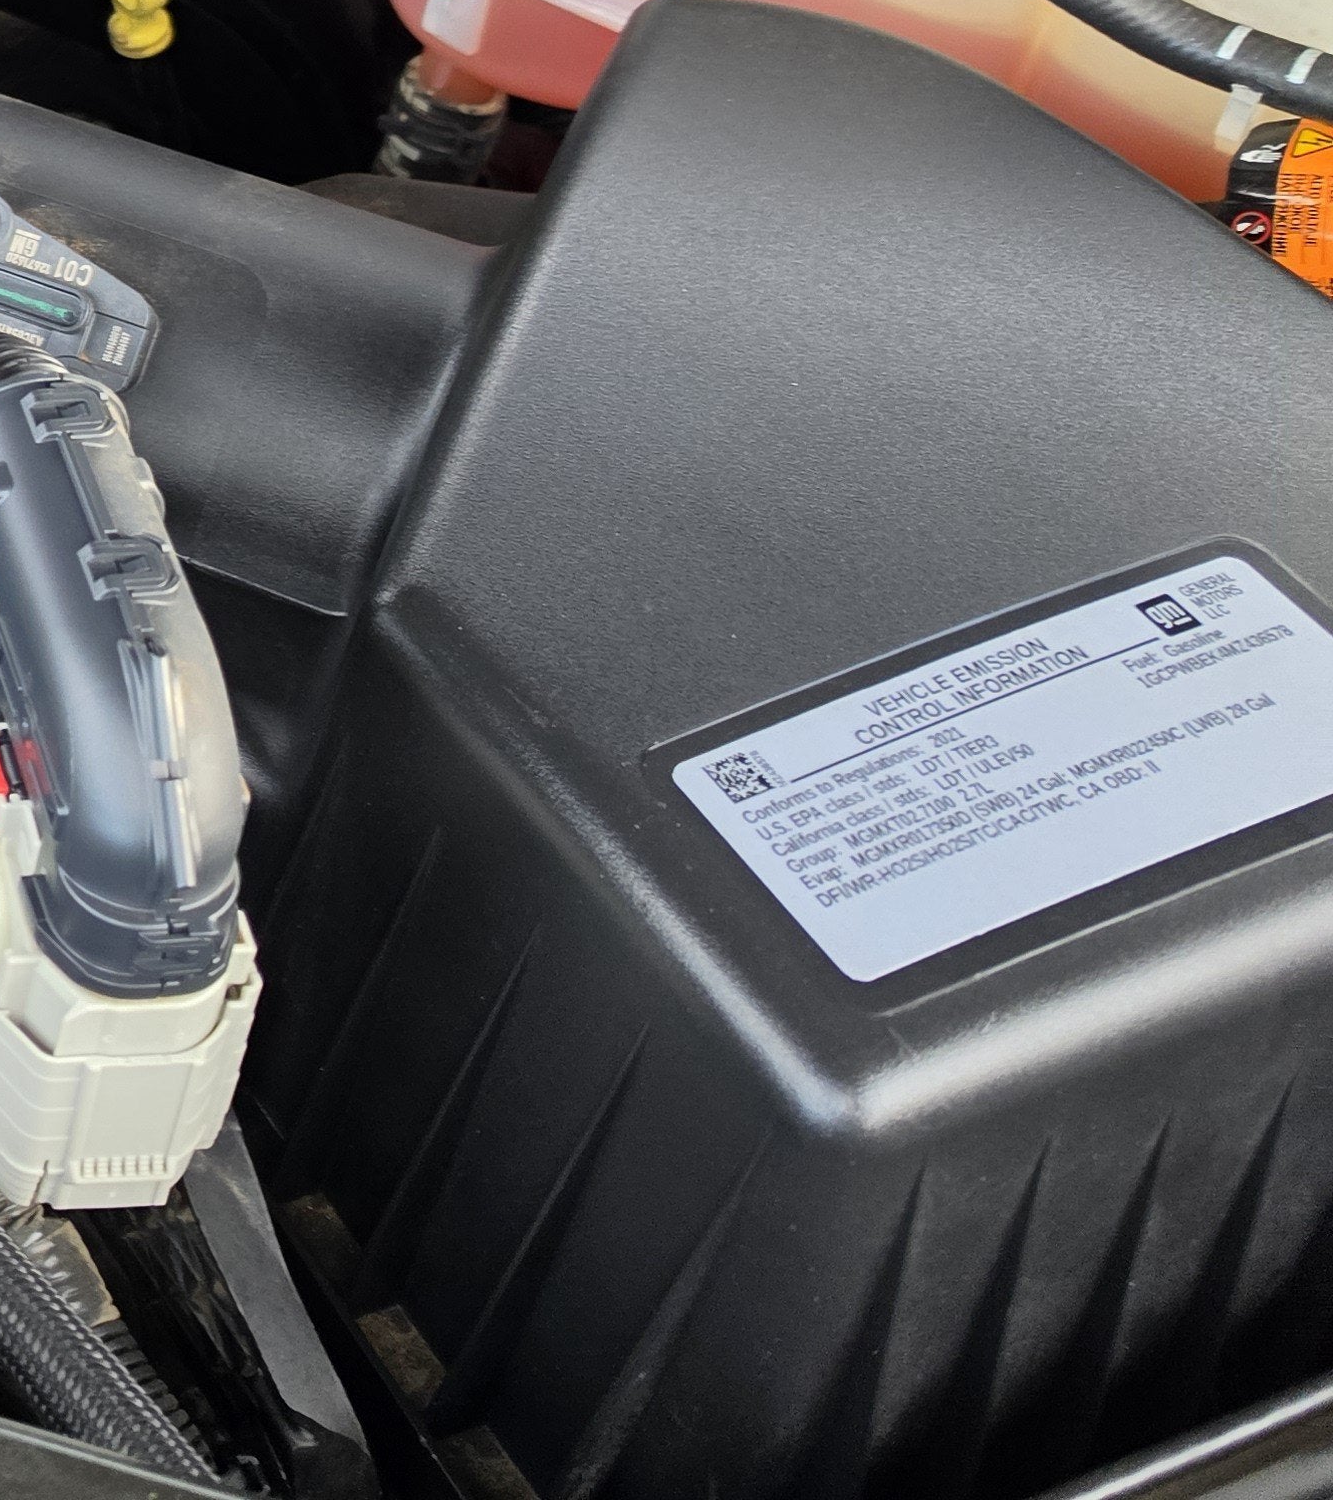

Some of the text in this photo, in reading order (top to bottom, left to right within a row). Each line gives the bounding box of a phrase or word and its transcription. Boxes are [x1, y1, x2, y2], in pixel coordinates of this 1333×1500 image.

[1145, 601, 1189, 630] gm
[1177, 572, 1237, 597] GENERAL
[1189, 583, 1244, 608] MOTORS
[1202, 603, 1231, 620] LLC
[861, 637, 1050, 717] VEHICLE EMISSION
[1121, 629, 1227, 673] Fuel: Gasoline
[853, 645, 1091, 745] CONTROL INFORMATION
[741, 726, 967, 825] Conforms to Regulations: 2021
[755, 821, 792, 841] U.S.
[788, 806, 826, 828] EPA
[825, 791, 866, 814] class
[872, 773, 912, 794] stds:
[912, 754, 947, 777] LDT
[950, 734, 1000, 760] TIER3
[770, 821, 847, 857] California
[845, 805, 886, 827] class
[893, 786, 932, 807] stds:
[932, 768, 968, 791] LDT
[973, 743, 1035, 774] ULEV50
[798, 865, 847, 891] Evap:
[969, 791, 1023, 821] (SWB)
[1015, 783, 1040, 801] 24
[1181, 710, 1234, 738] (LWB)
[1244, 692, 1277, 712] Gal
[1076, 781, 1107, 800] CA
[1142, 759, 1162, 774] II
[785, 845, 842, 874] Group:
[956, 781, 995, 803] 2.7L
